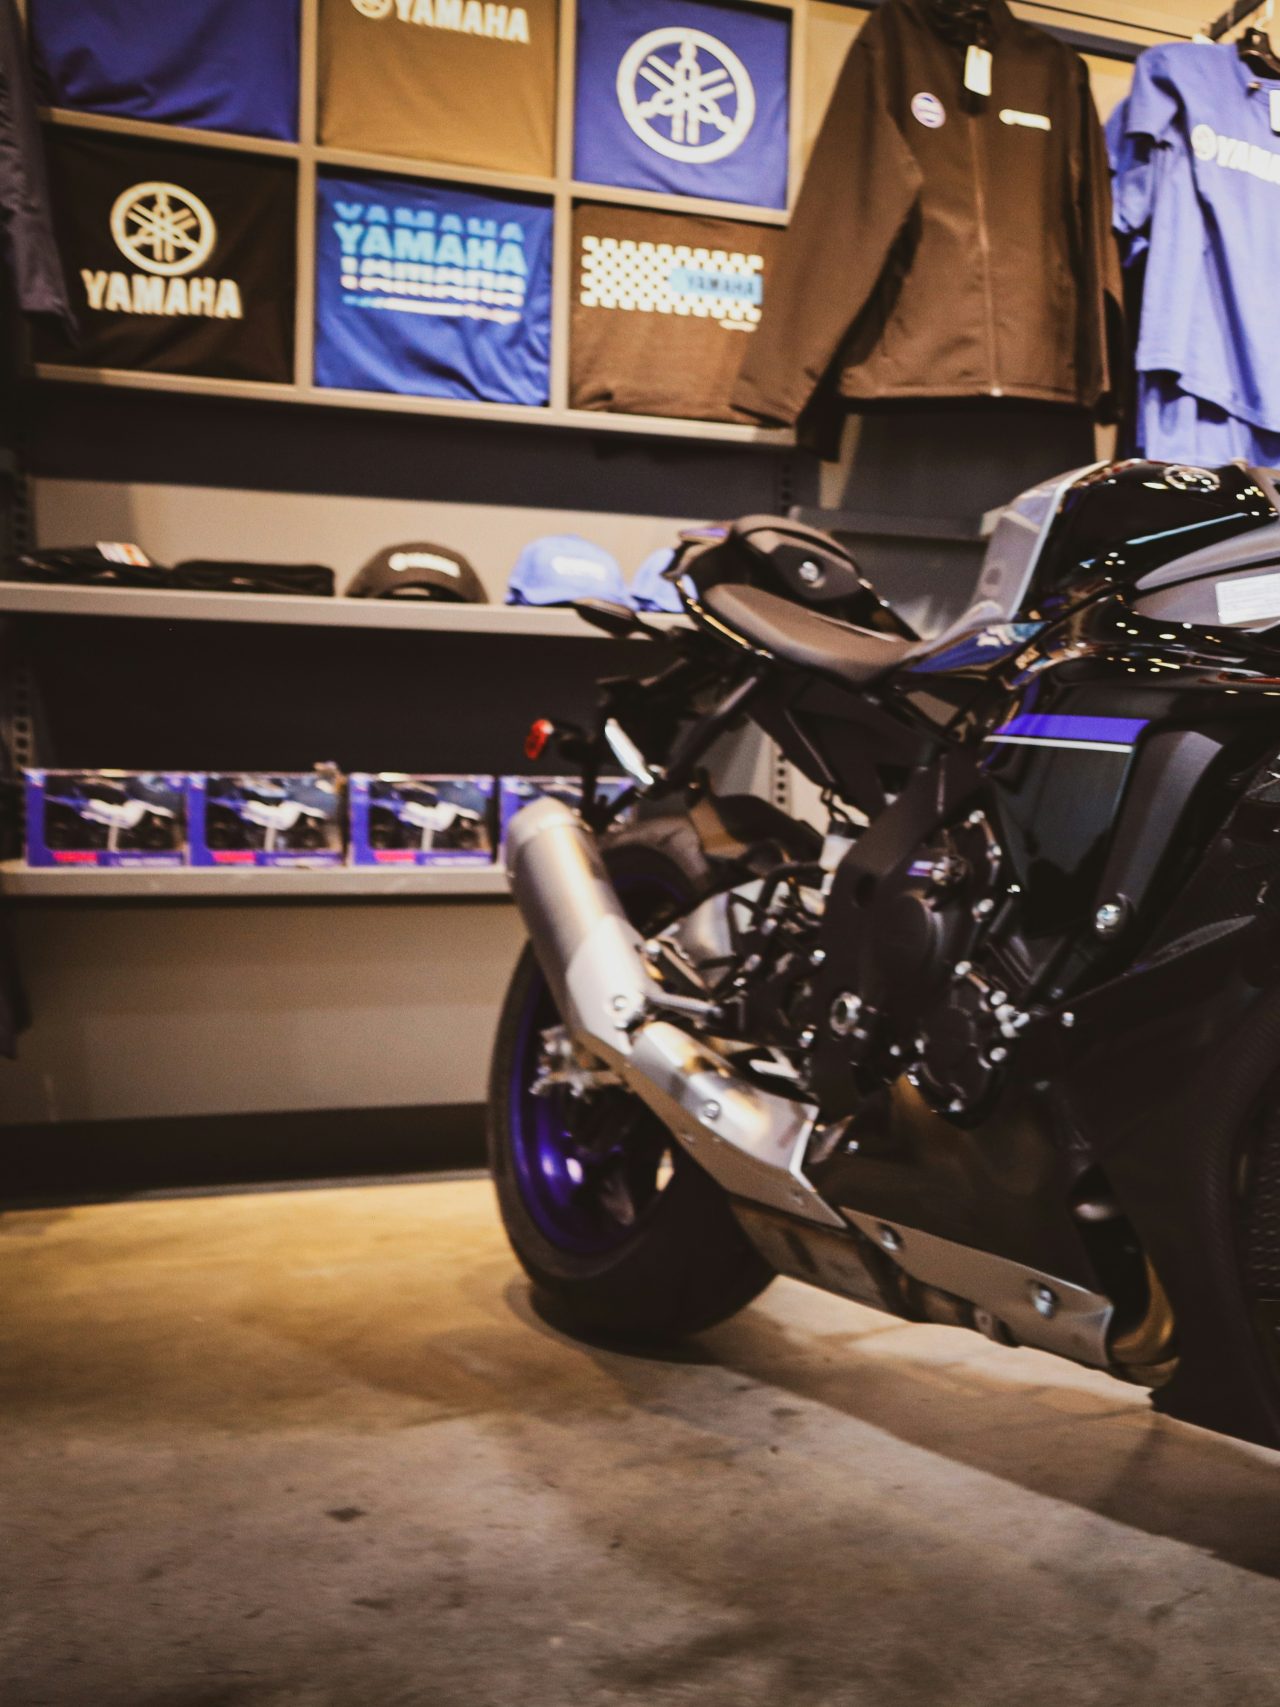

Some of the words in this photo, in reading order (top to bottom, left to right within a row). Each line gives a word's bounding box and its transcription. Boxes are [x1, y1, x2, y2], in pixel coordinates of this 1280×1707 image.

[396, 0, 530, 44] YAMAHA
[333, 221, 528, 275] YAMAHA
[80, 268, 243, 319] YAMAHA
